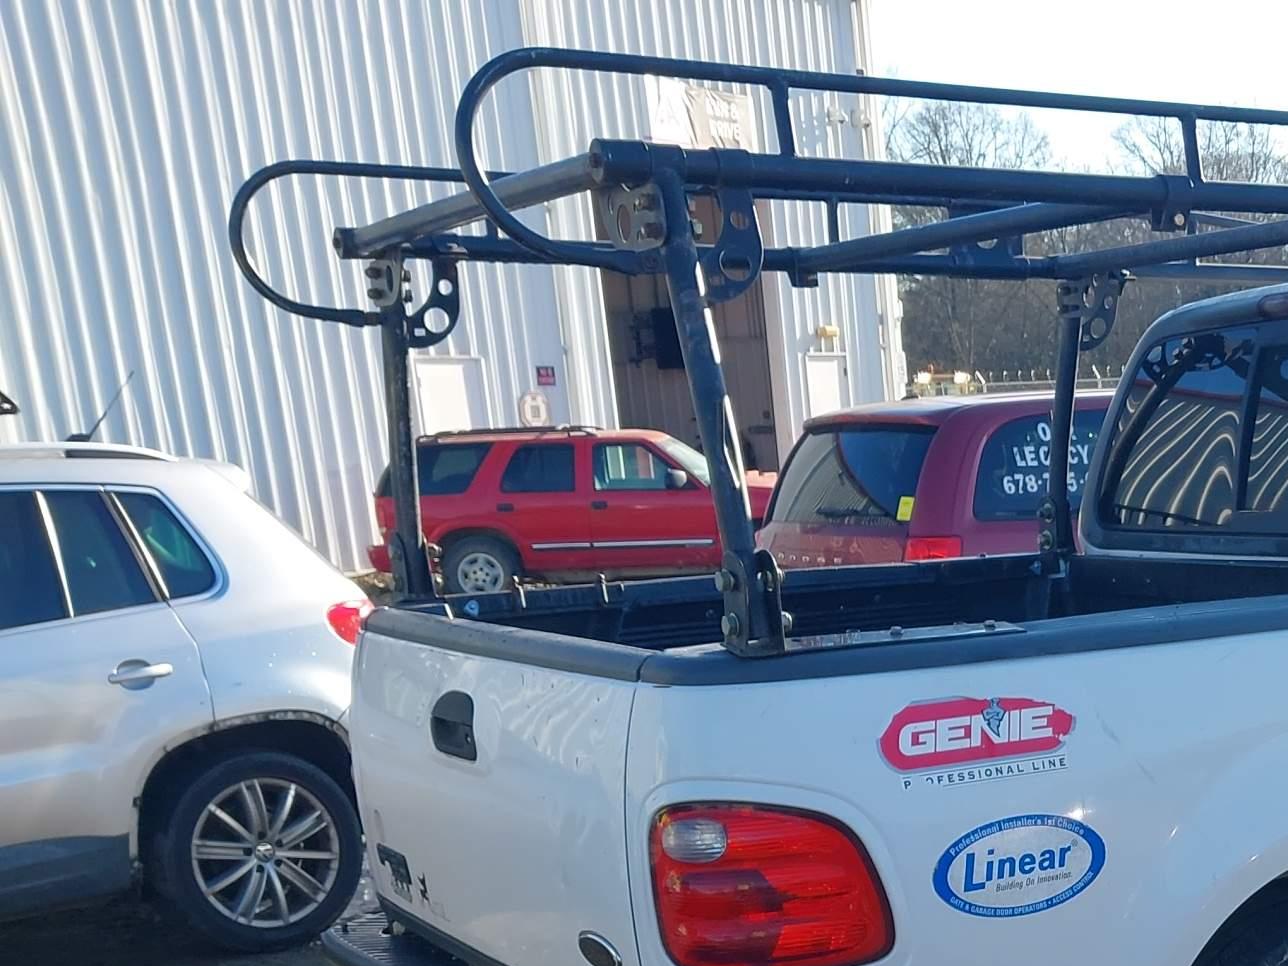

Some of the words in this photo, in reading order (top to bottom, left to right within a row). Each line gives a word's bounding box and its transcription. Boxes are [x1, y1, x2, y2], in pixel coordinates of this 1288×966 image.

[899, 705, 1054, 756] GENIE
[1032, 757, 1067, 770] LINE
[963, 845, 1072, 892] Linear
[996, 880, 1024, 893] Building
[1025, 877, 1035, 887] On
